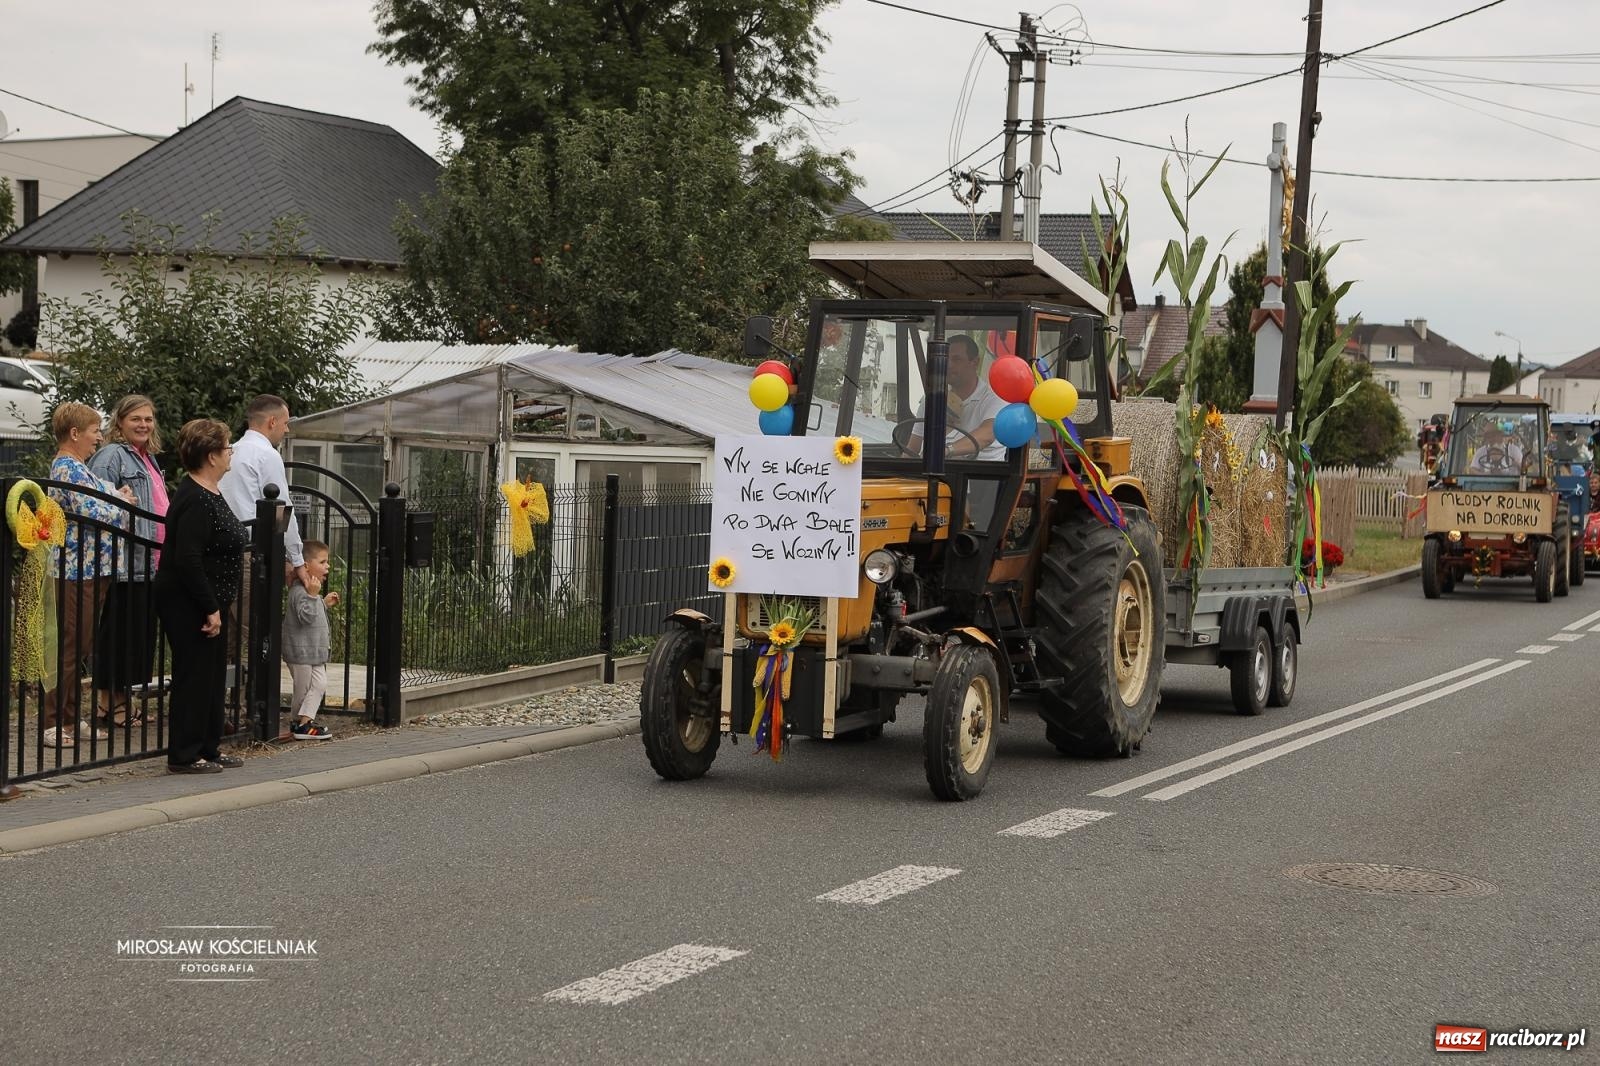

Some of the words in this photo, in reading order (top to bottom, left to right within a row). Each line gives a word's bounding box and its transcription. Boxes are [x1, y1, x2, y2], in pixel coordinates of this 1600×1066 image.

[761, 460, 779, 474] SE
[741, 477, 764, 502] NIE
[773, 481, 837, 504] GONIMY
[1440, 492, 1492, 508] MŁODY
[1496, 495, 1542, 512] ROLNIK
[723, 513, 749, 530] PO
[753, 514, 798, 532] DWA
[805, 511, 855, 534] BALE
[1456, 512, 1476, 525] NA
[1483, 511, 1538, 527] DOROBKU
[751, 543, 775, 560] SE
